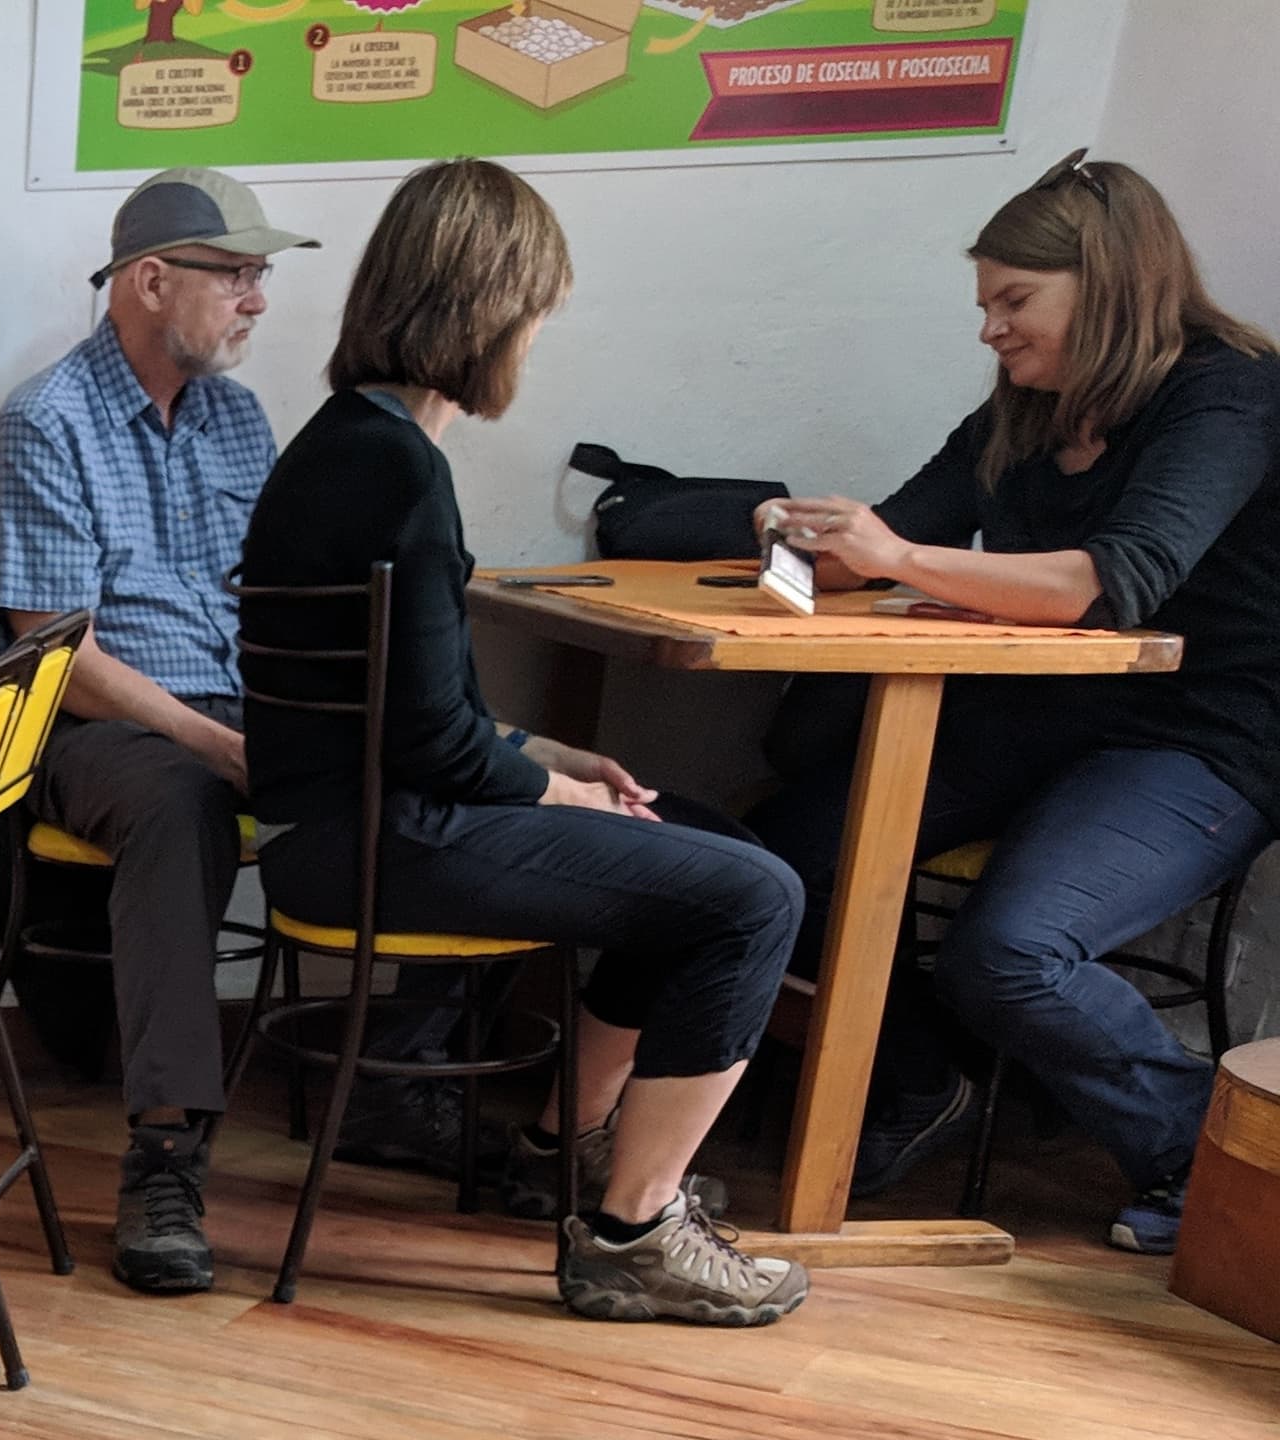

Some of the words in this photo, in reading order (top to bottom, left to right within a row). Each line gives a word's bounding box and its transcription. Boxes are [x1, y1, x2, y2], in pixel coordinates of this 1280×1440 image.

[313, 29, 324, 45] 2
[729, 66, 791, 87] PROCESO
[796, 63, 813, 83] DE
[818, 60, 880, 82] COSECHA
[887, 58, 896, 79] Y
[900, 55, 991, 79] POSCOSECHA
